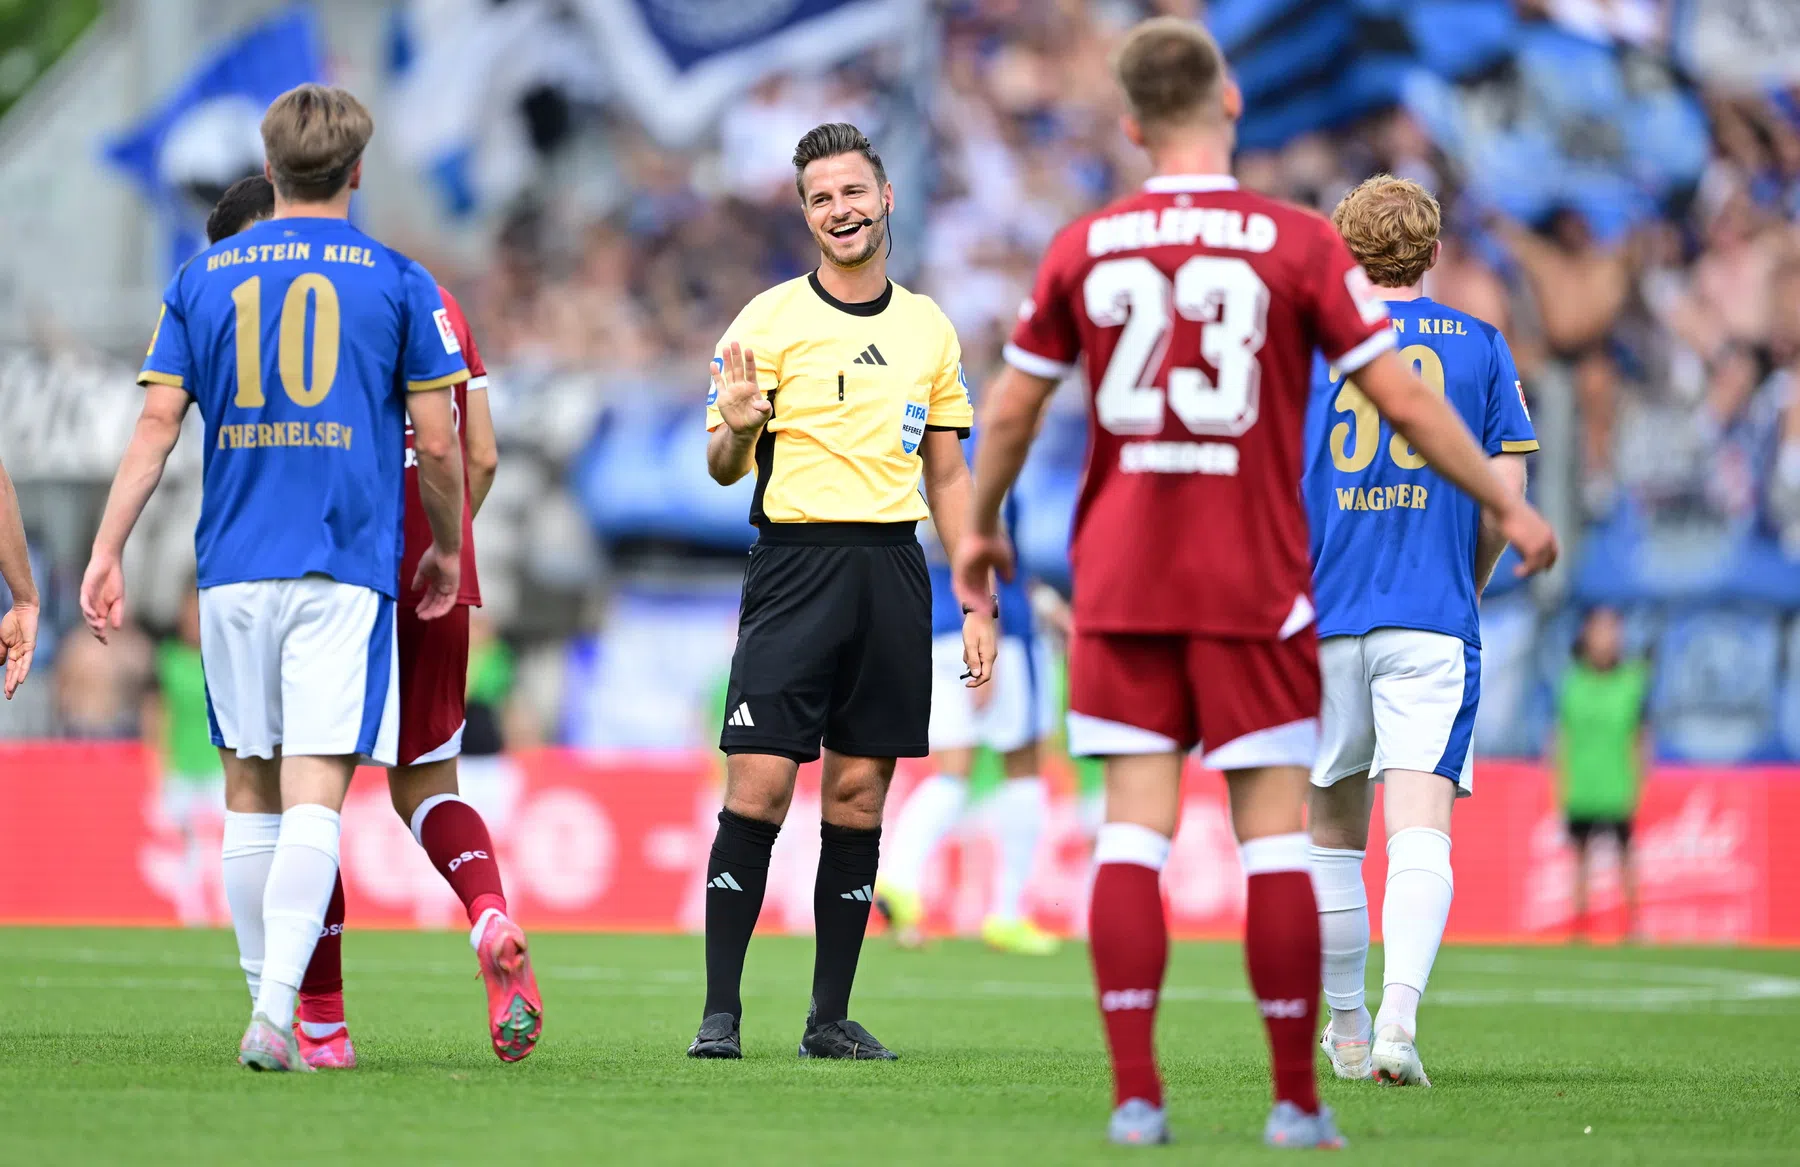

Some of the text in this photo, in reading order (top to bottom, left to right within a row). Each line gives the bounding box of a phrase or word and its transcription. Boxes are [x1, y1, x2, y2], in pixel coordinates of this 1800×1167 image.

[206, 242, 376, 272] HOLSTEIN KIEL
[230, 272, 340, 408] 10
[1418, 317, 1468, 336] KIEL
[1082, 255, 1270, 437] 23
[905, 403, 926, 421] FIFA
[218, 421, 352, 451] THERKELSEN
[902, 423, 922, 436] REFEREE
[1336, 483, 1428, 511] WAGNER
[448, 850, 489, 872] DSC
